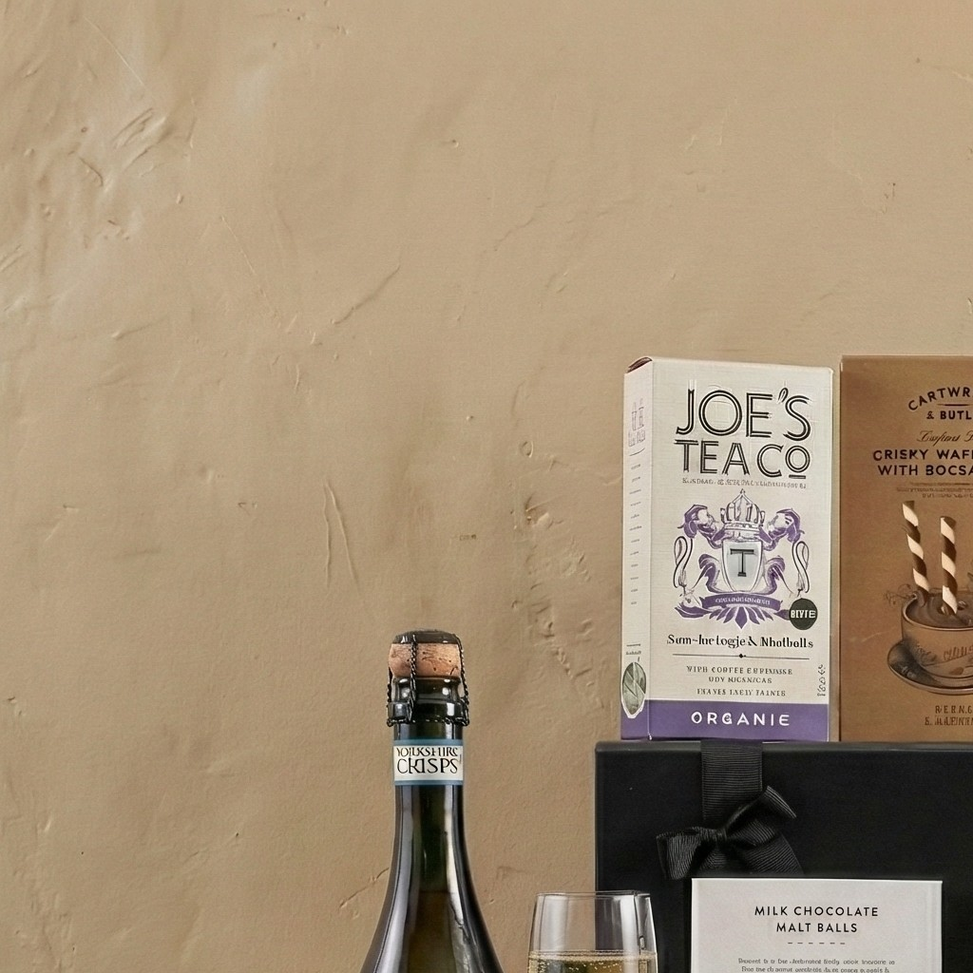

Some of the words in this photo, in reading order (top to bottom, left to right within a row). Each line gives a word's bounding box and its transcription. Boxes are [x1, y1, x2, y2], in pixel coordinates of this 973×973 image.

[675, 386, 812, 442] JOE'S
[925, 410, 935, 420] &
[674, 439, 751, 476] TEA
[872, 449, 929, 462] CRISKY
[877, 464, 919, 476] WITH
[690, 710, 791, 727] ORGANIE
[754, 905, 789, 917] MILK
[793, 905, 879, 917] CHOCOLATE
[776, 922, 812, 933] MALT
[817, 922, 858, 934] BALLS
